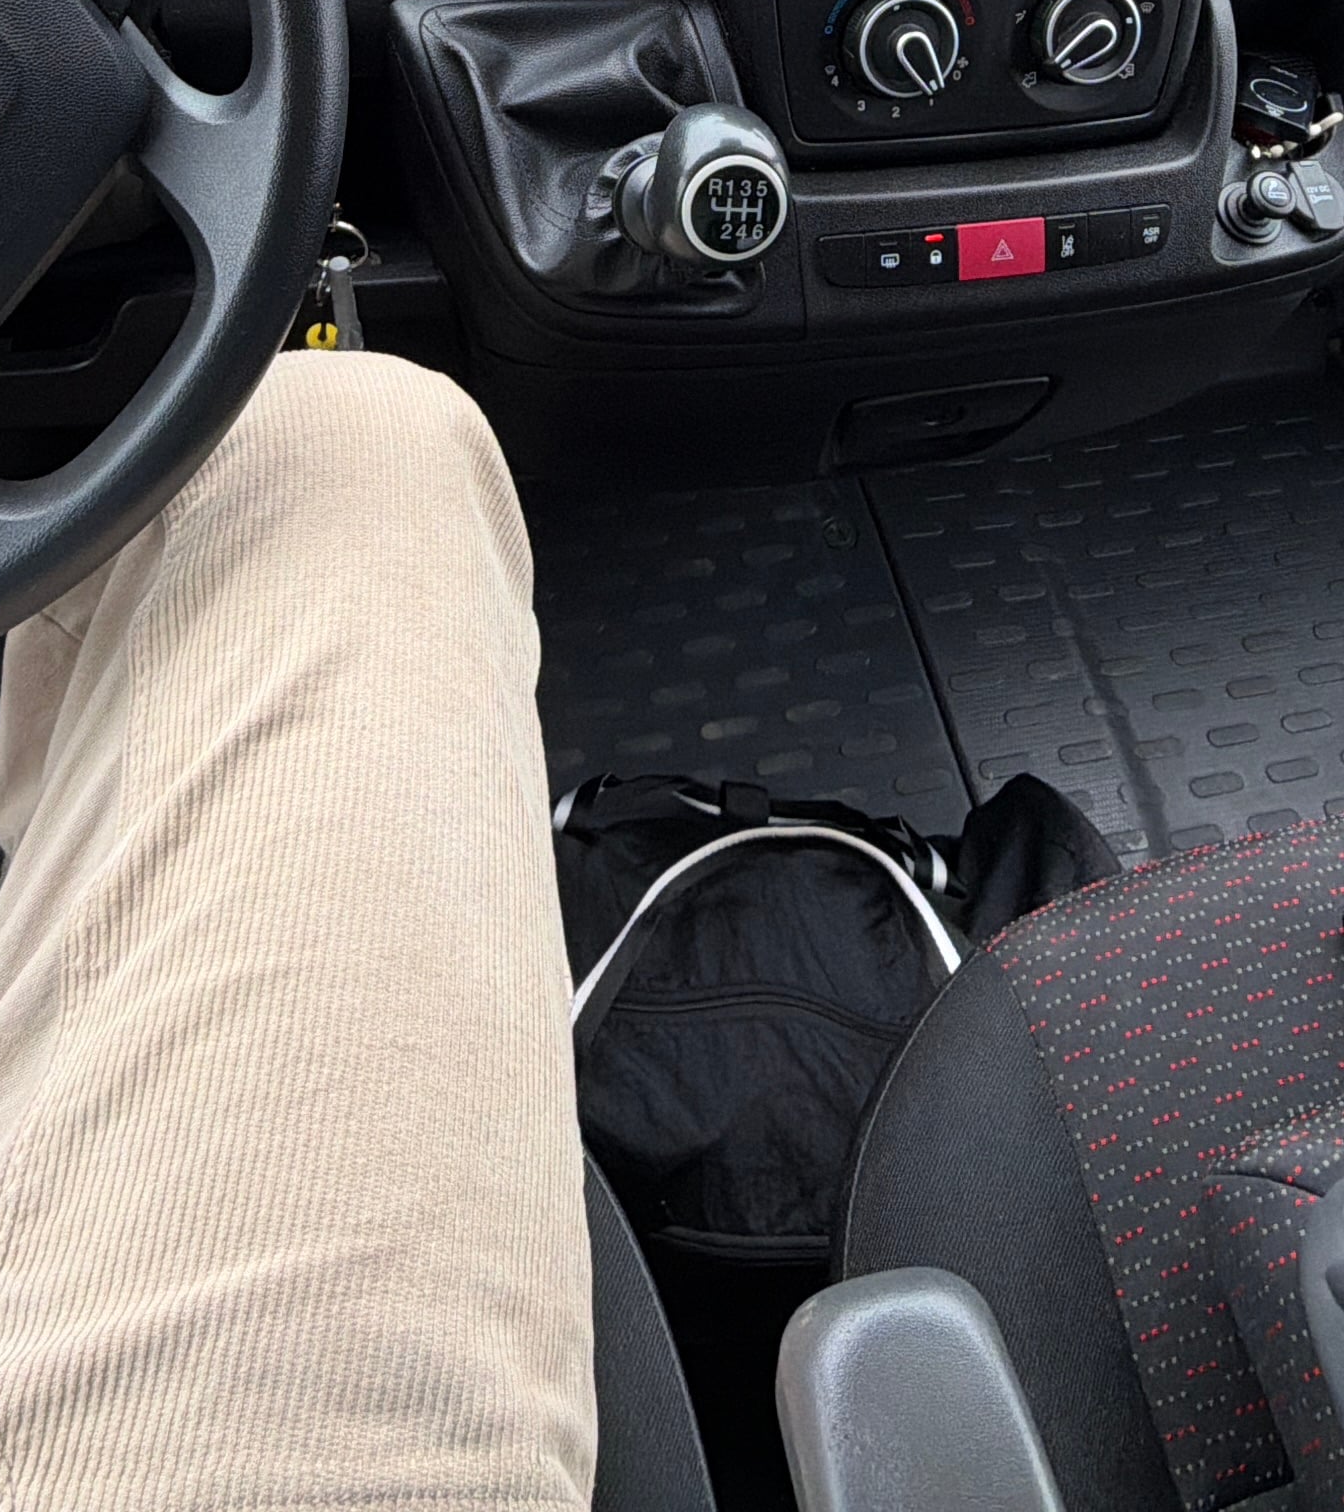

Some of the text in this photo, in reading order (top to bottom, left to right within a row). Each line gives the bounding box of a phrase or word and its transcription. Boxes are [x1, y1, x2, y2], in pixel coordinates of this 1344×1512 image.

[830, 75, 839, 87] 4
[857, 100, 866, 112] 3
[892, 106, 901, 118] 2
[1143, 227, 1160, 236] ASR
